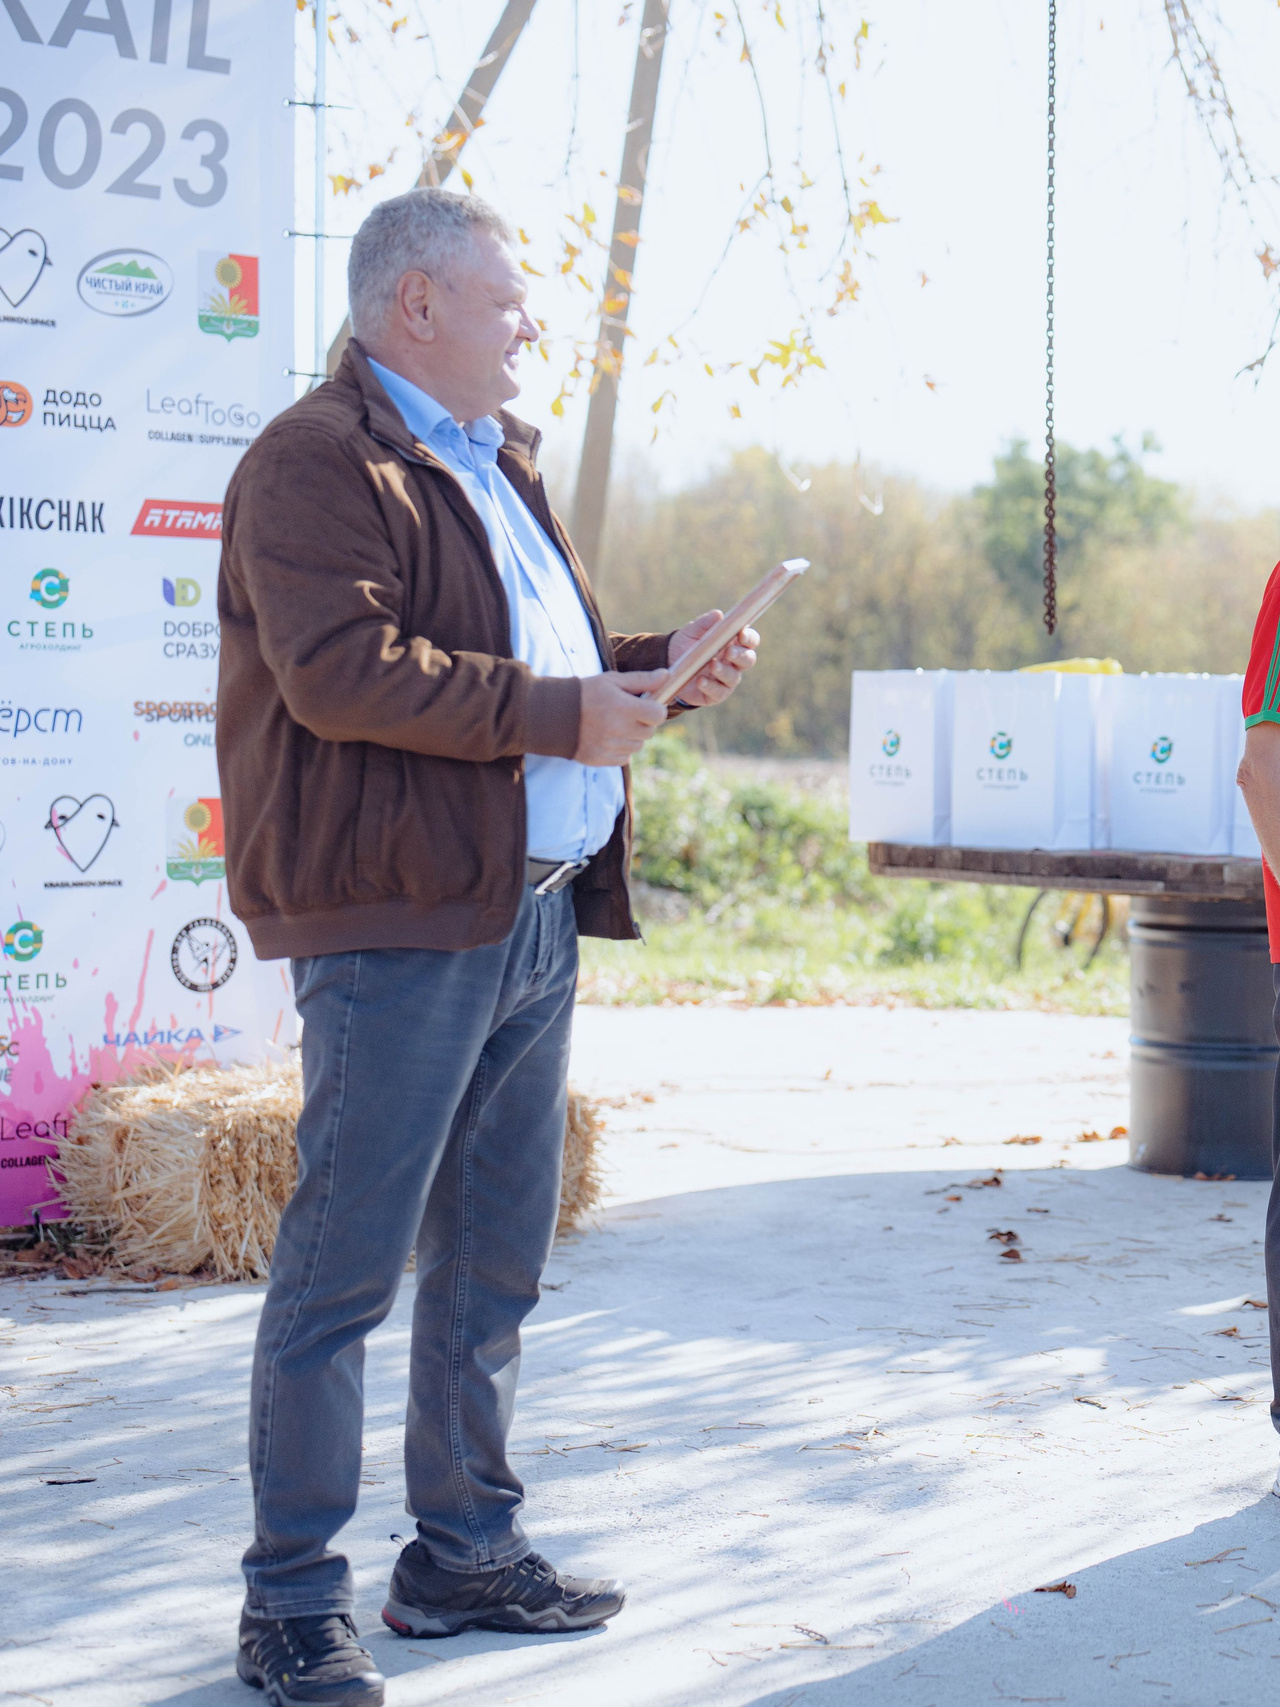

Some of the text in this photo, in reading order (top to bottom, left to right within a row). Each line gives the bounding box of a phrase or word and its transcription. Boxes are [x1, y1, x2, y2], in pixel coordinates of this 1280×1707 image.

[85, 276, 132, 291] ЧИСТЫЙ
[135, 281, 164, 295] КРАЙ
[44, 388, 102, 408] ДОДО
[43, 411, 117, 433] ПИЦЦА
[7, 620, 94, 639] СТЕПЬ
[976, 767, 1029, 782] СТЕПЬ
[1132, 771, 1186, 786] СТЕПЬ
